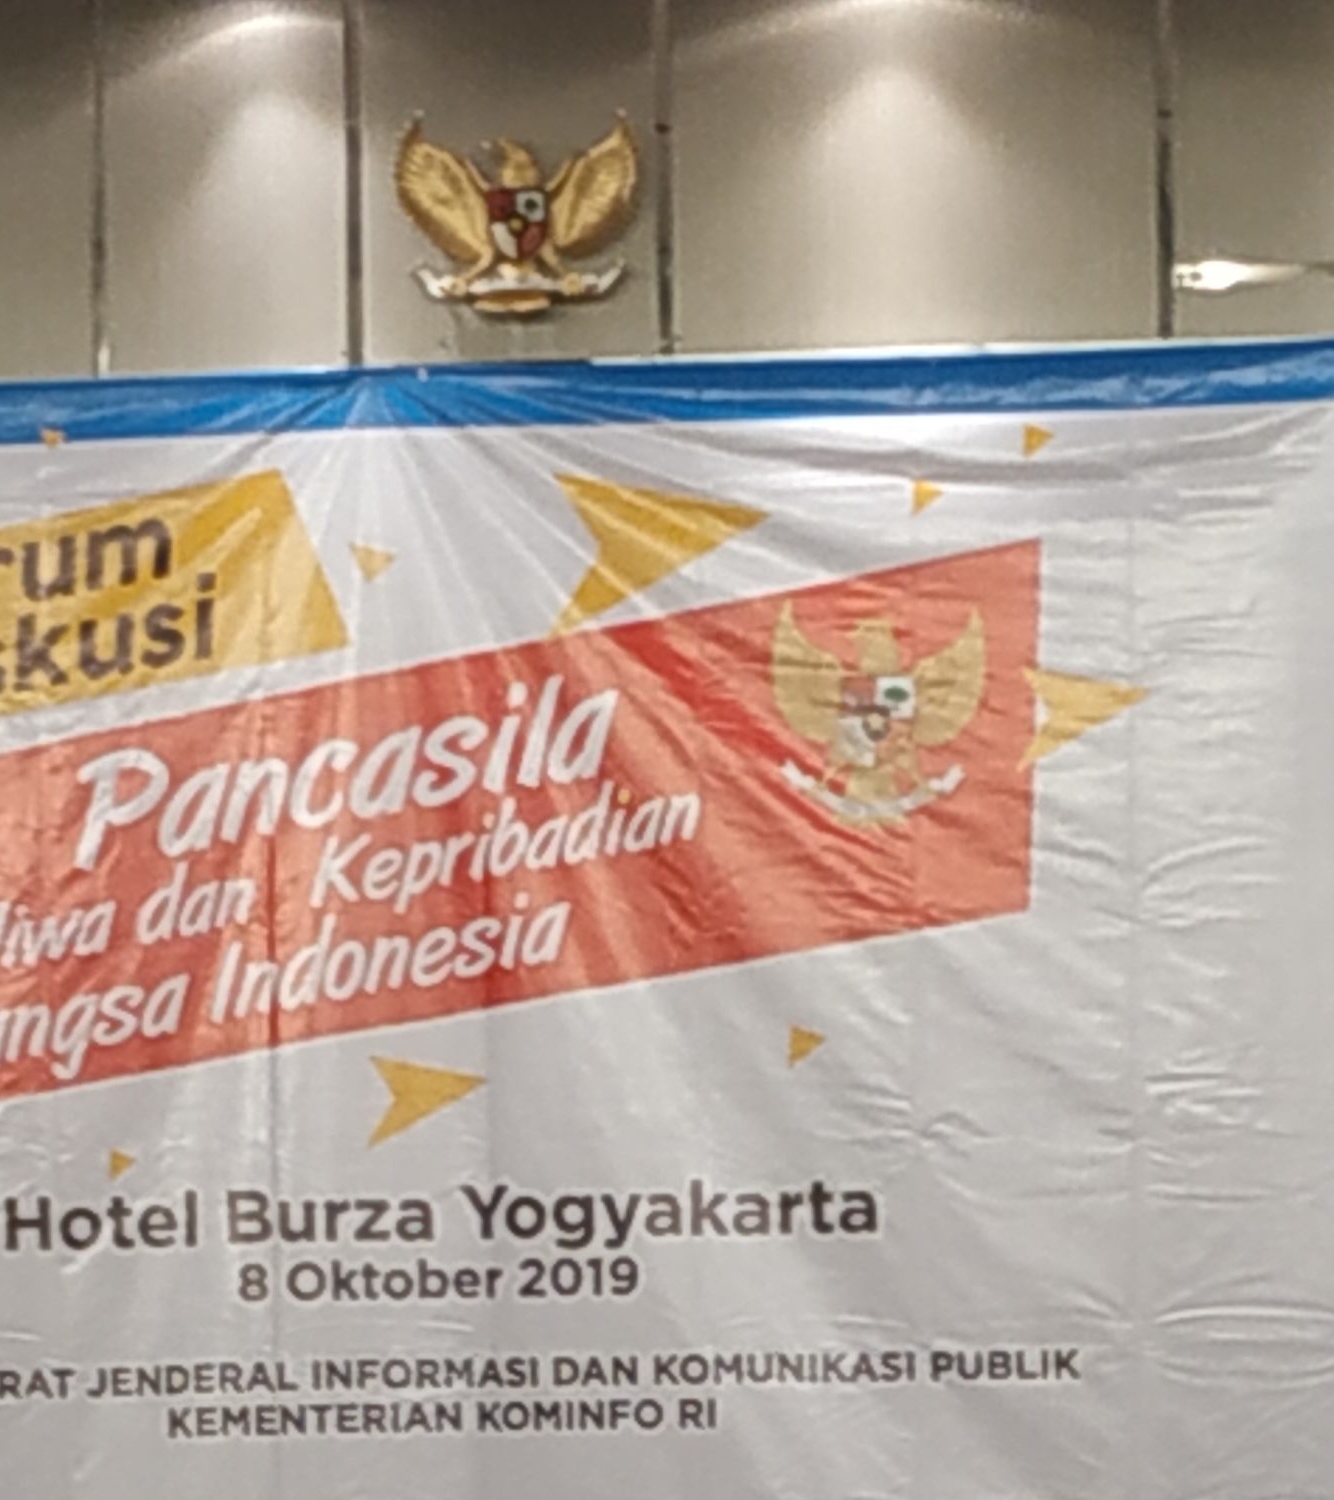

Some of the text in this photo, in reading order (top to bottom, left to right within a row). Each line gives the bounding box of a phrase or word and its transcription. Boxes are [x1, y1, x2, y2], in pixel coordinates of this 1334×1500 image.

[75, 674, 619, 870] Pancasila
[137, 866, 255, 946] dan
[309, 783, 701, 914] Kepribadian
[210, 892, 570, 1024] Indonesia
[3, 1179, 879, 1252] Hotel Burza Yogyakarta
[238, 1256, 640, 1302] 8 Oktober 2019
[86, 1363, 298, 1398] JENDERAL
[312, 1357, 540, 1391] INFORMASI
[553, 1356, 639, 1387] DAN
[653, 1351, 917, 1386] KOMUNIKASI
[930, 1348, 1080, 1382] PUBLIK
[167, 1397, 718, 1440] KEMENTERIAN KOMINFO RI
